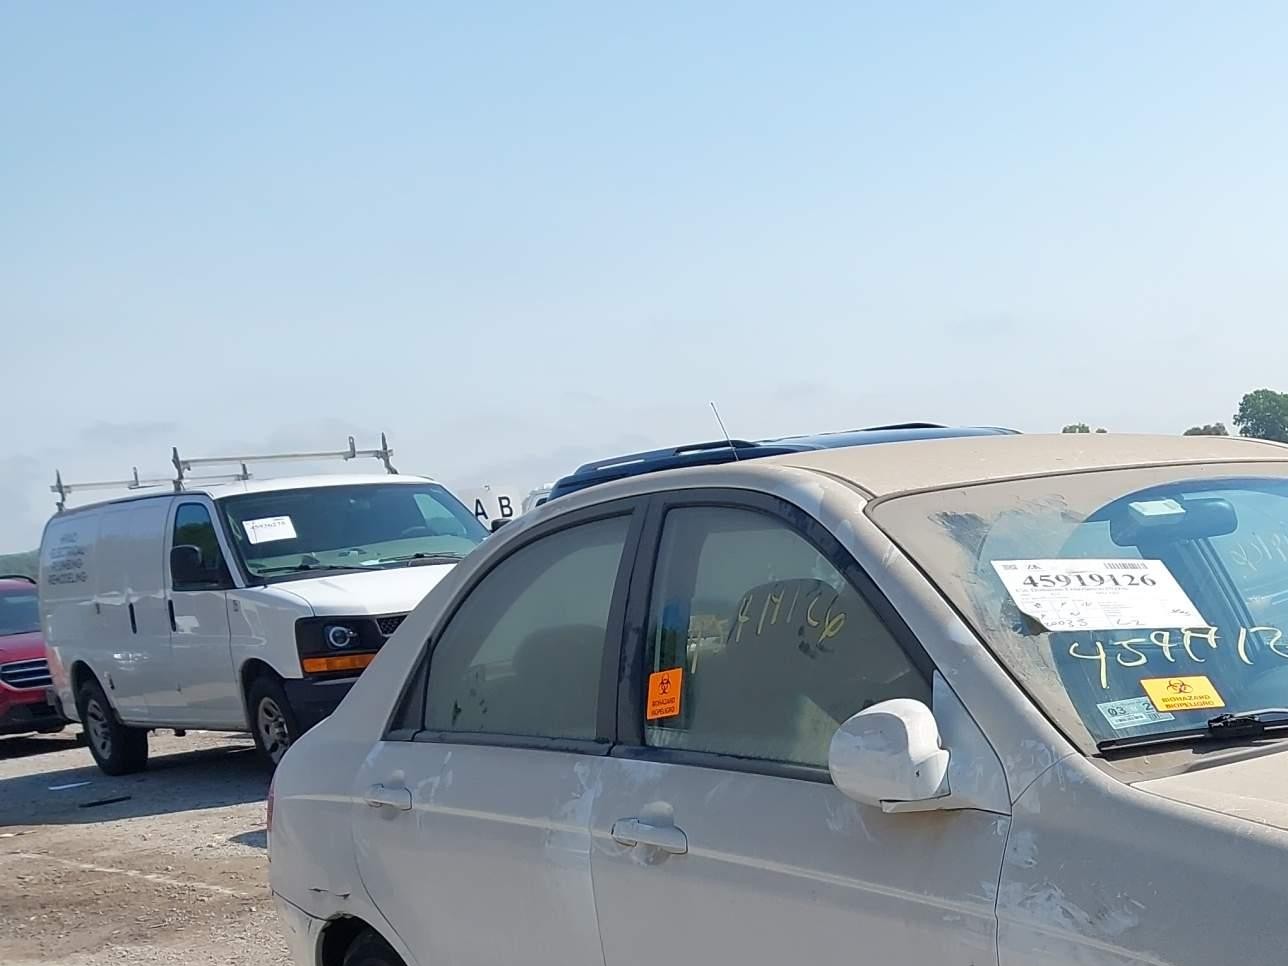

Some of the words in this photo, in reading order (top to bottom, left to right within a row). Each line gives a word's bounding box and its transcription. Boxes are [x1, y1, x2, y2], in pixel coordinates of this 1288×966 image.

[474, 499, 489, 520] A
[498, 496, 513, 517] B
[1022, 573, 1157, 588] 45919126
[1161, 694, 1211, 703] BIOHAZARD
